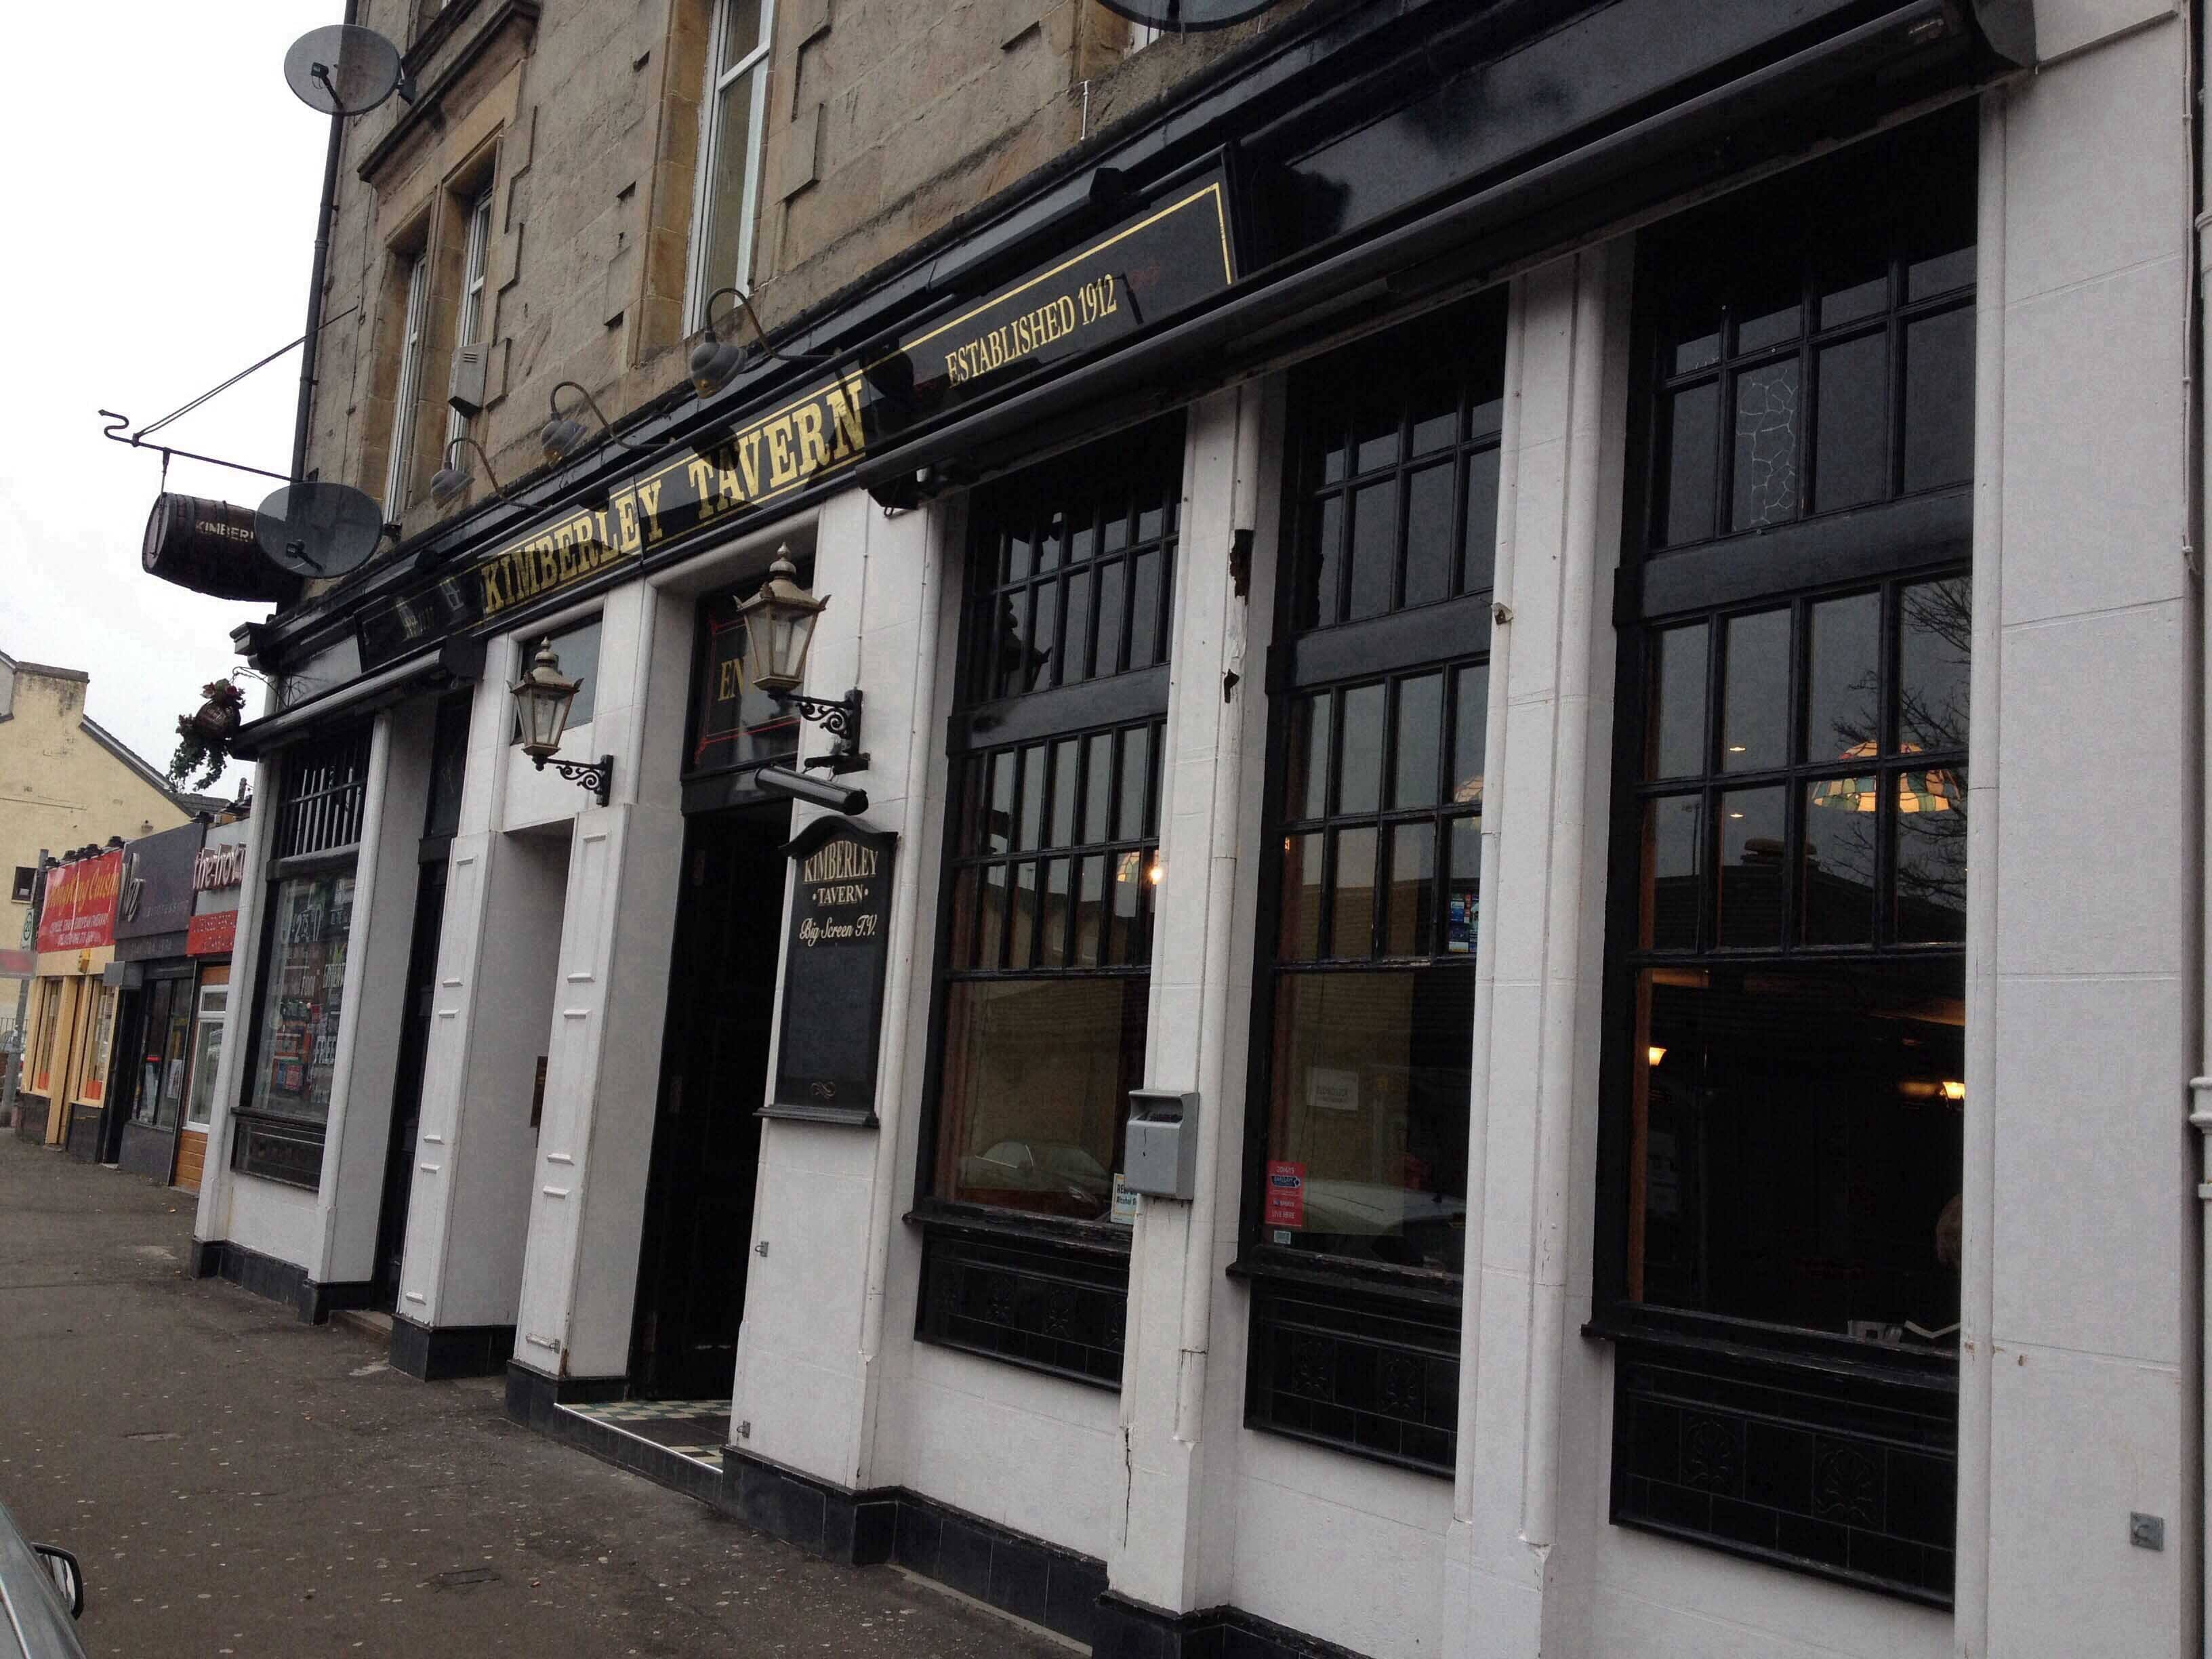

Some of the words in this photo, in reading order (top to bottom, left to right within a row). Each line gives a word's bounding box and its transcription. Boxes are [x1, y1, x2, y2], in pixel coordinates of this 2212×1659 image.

[945, 295, 1076, 386] ESTABLISHED
[1078, 273, 1118, 326] 1912
[480, 479, 663, 614] KIMBERLEY
[688, 379, 865, 520] TAVERN
[804, 840, 878, 882] KIMBERLEY
[818, 884, 864, 904] TAVERN
[800, 918, 820, 946] Big
[821, 917, 853, 939] Screen
[855, 914, 878, 936] T.V.
